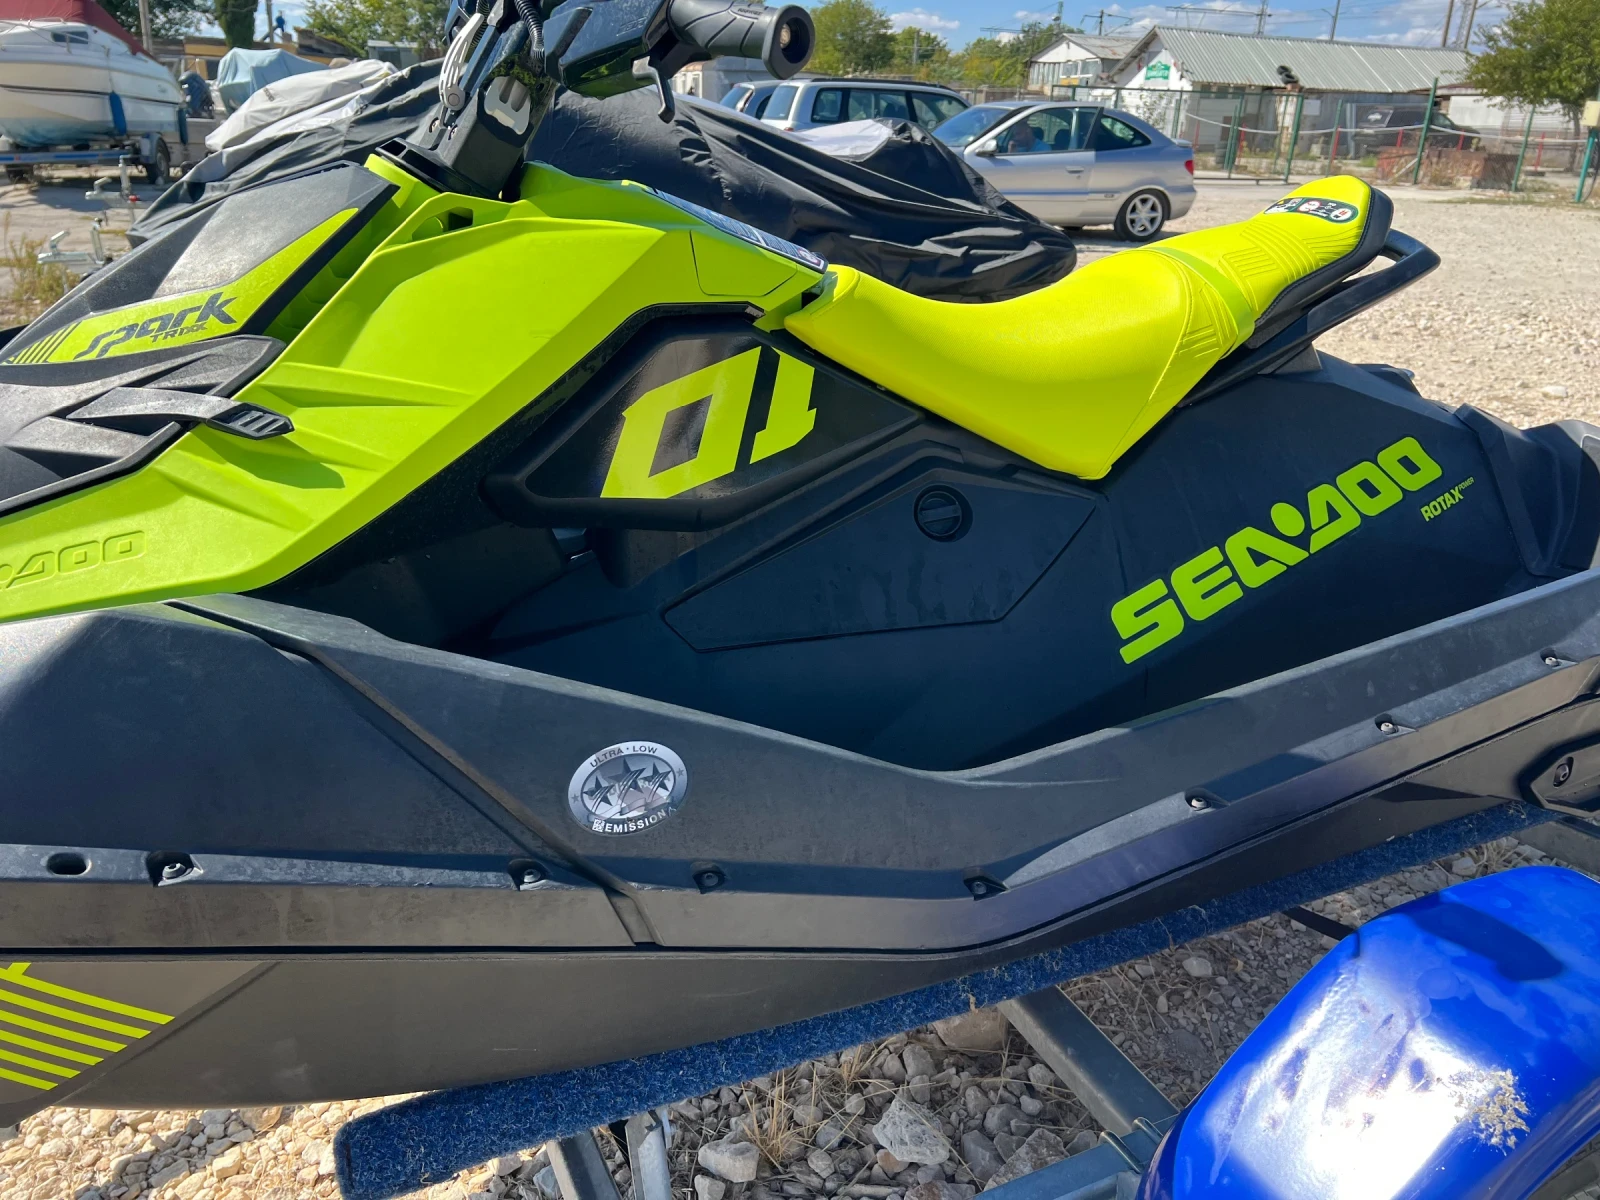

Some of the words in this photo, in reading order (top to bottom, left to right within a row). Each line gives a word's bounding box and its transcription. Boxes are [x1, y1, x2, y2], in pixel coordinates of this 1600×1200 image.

[150, 321, 209, 343] TRIXX
[1420, 486, 1464, 522] ROTAX
[1458, 476, 1475, 491] POWER
[589, 747, 624, 768] ULTRA
[632, 745, 658, 754] LOW
[604, 808, 667, 833] EMISSION
